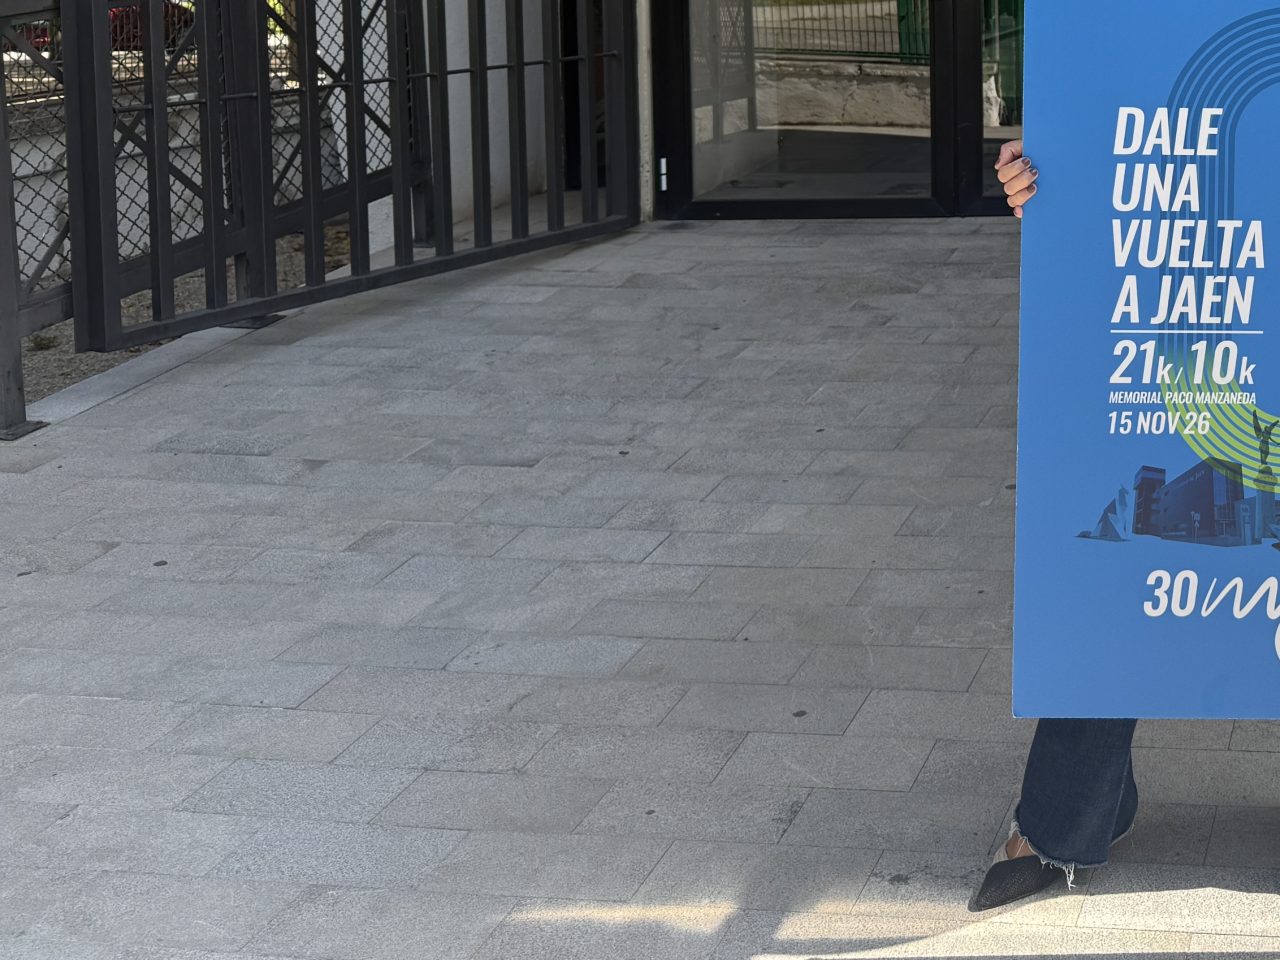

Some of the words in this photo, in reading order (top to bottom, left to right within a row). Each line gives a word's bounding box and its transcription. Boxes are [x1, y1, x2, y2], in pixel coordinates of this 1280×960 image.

[1113, 106, 1223, 156] DALE
[1112, 163, 1200, 212] UNA
[1112, 219, 1265, 268] VUELTA
[1110, 275, 1140, 323] A
[1191, 340, 1256, 385] 10k
[1109, 392, 1162, 404] MEMORIAL
[1165, 392, 1194, 404] PACO
[1195, 392, 1256, 405] MANZANEDA
[1108, 411, 1133, 435] 15
[1136, 411, 1181, 435] NOV
[1183, 412, 1211, 435] 26
[1144, 569, 1198, 617] 30
